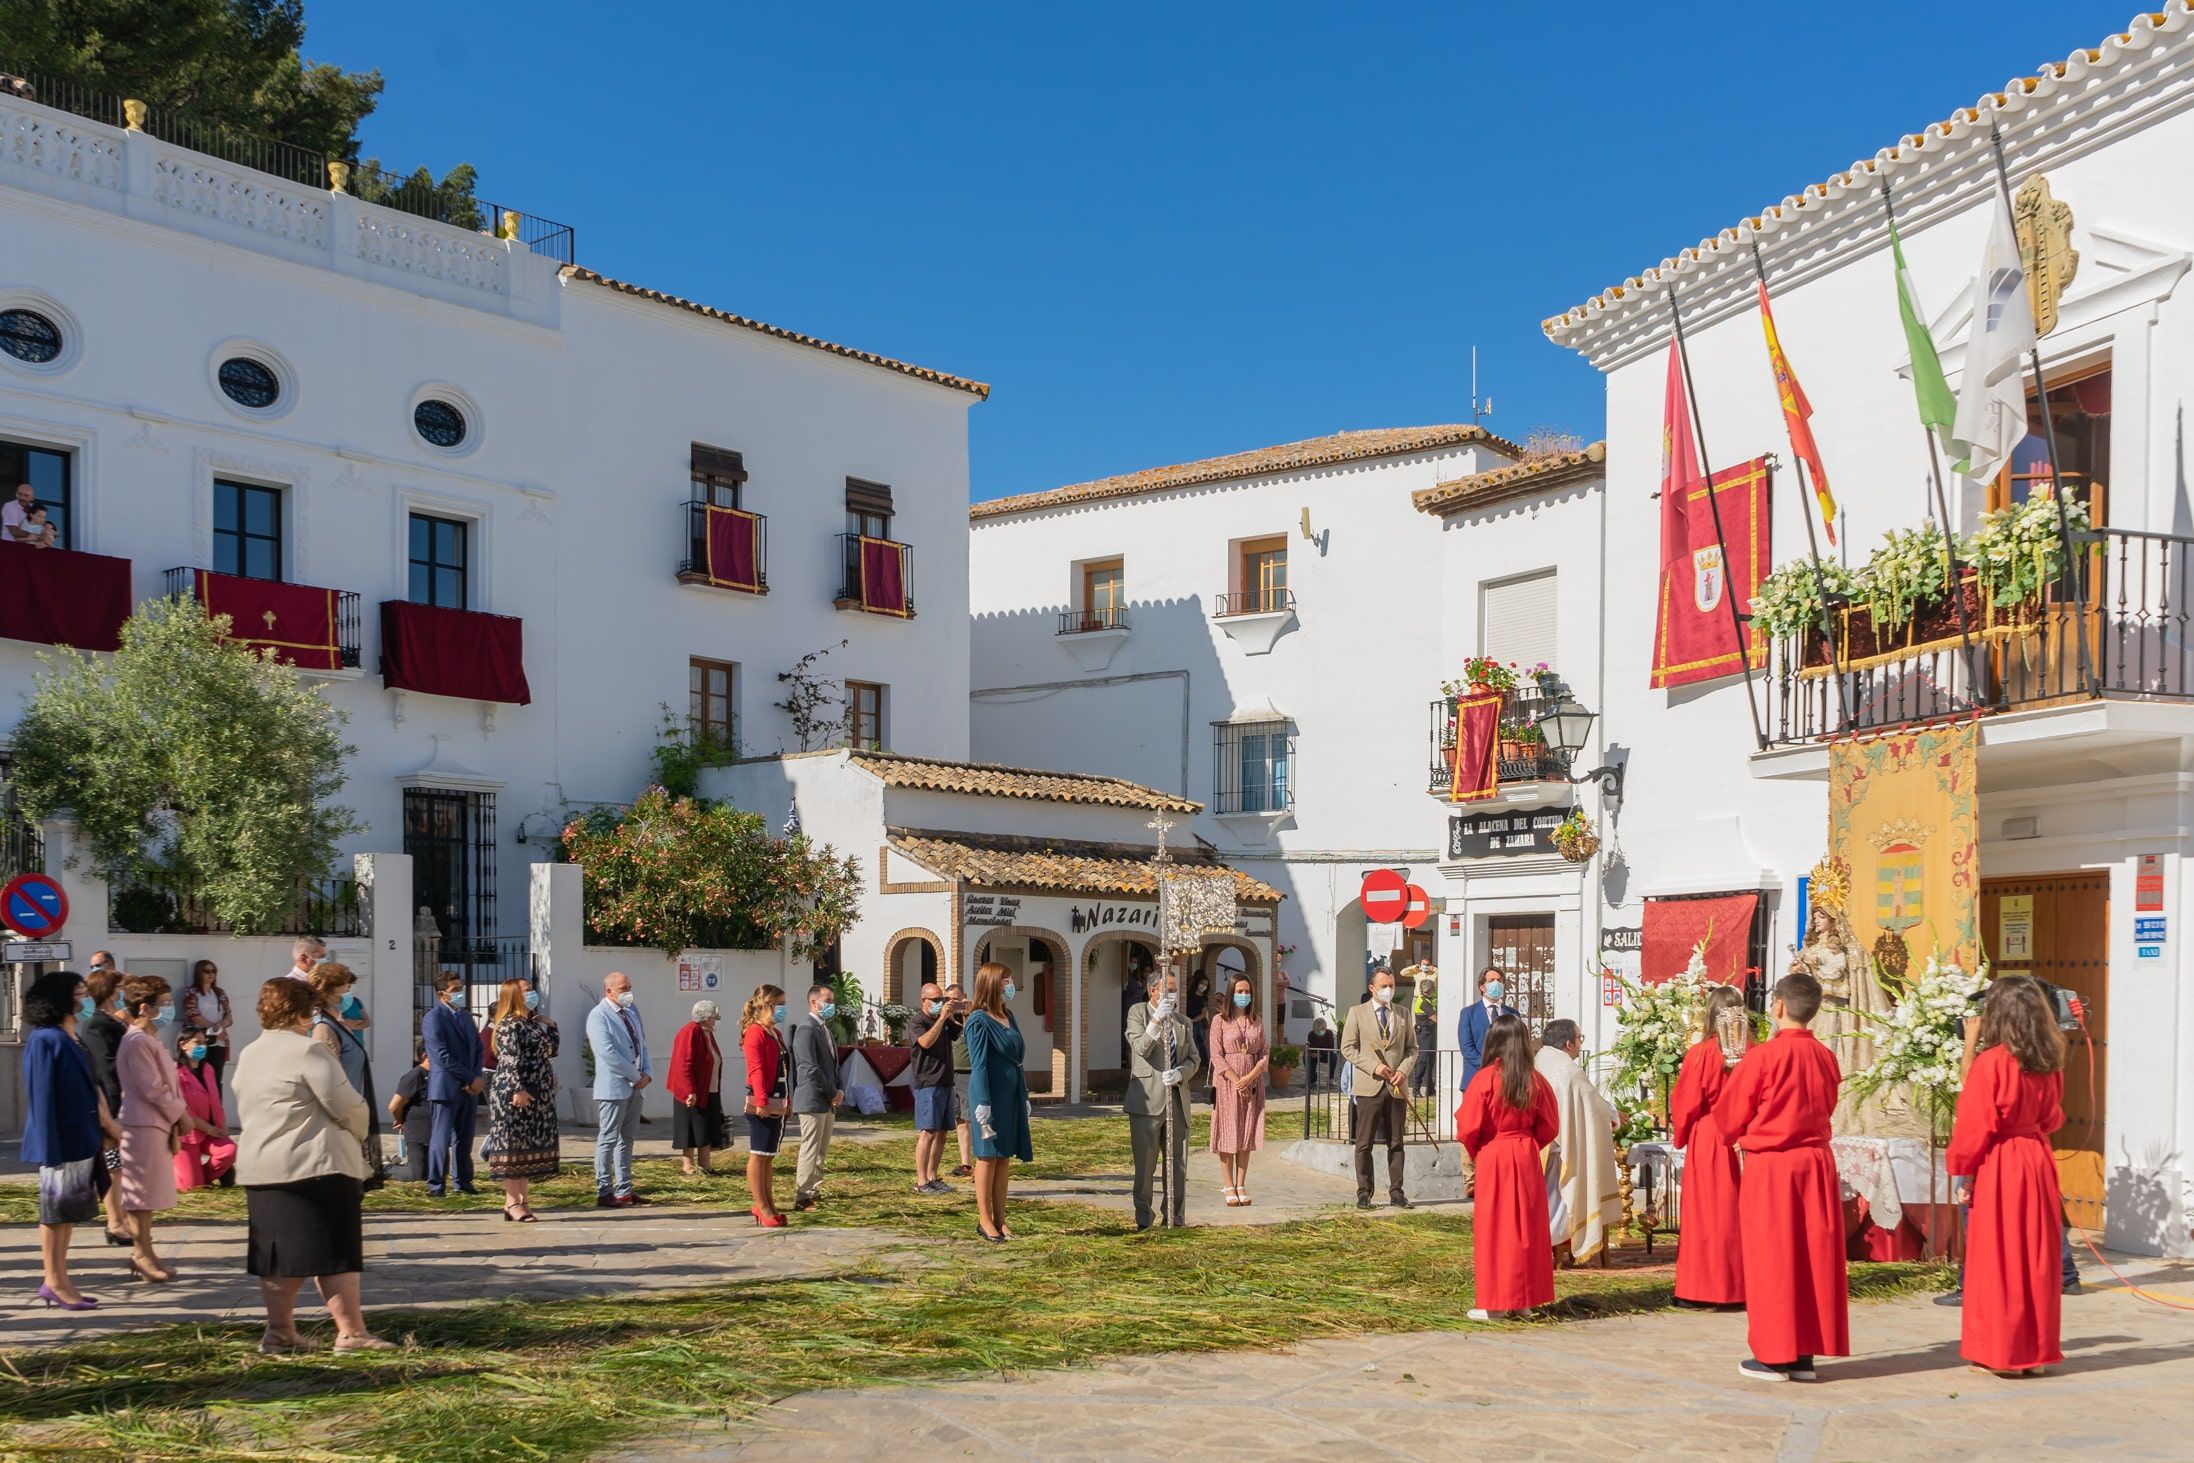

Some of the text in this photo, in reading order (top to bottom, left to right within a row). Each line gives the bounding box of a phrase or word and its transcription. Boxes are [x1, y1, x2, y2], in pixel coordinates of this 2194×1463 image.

[1463, 823, 1473, 835] LA
[1478, 818, 1509, 833] ALACENA
[1513, 818, 1528, 830] DEL
[1490, 837, 1501, 849] DE
[389, 939, 396, 950] 2
